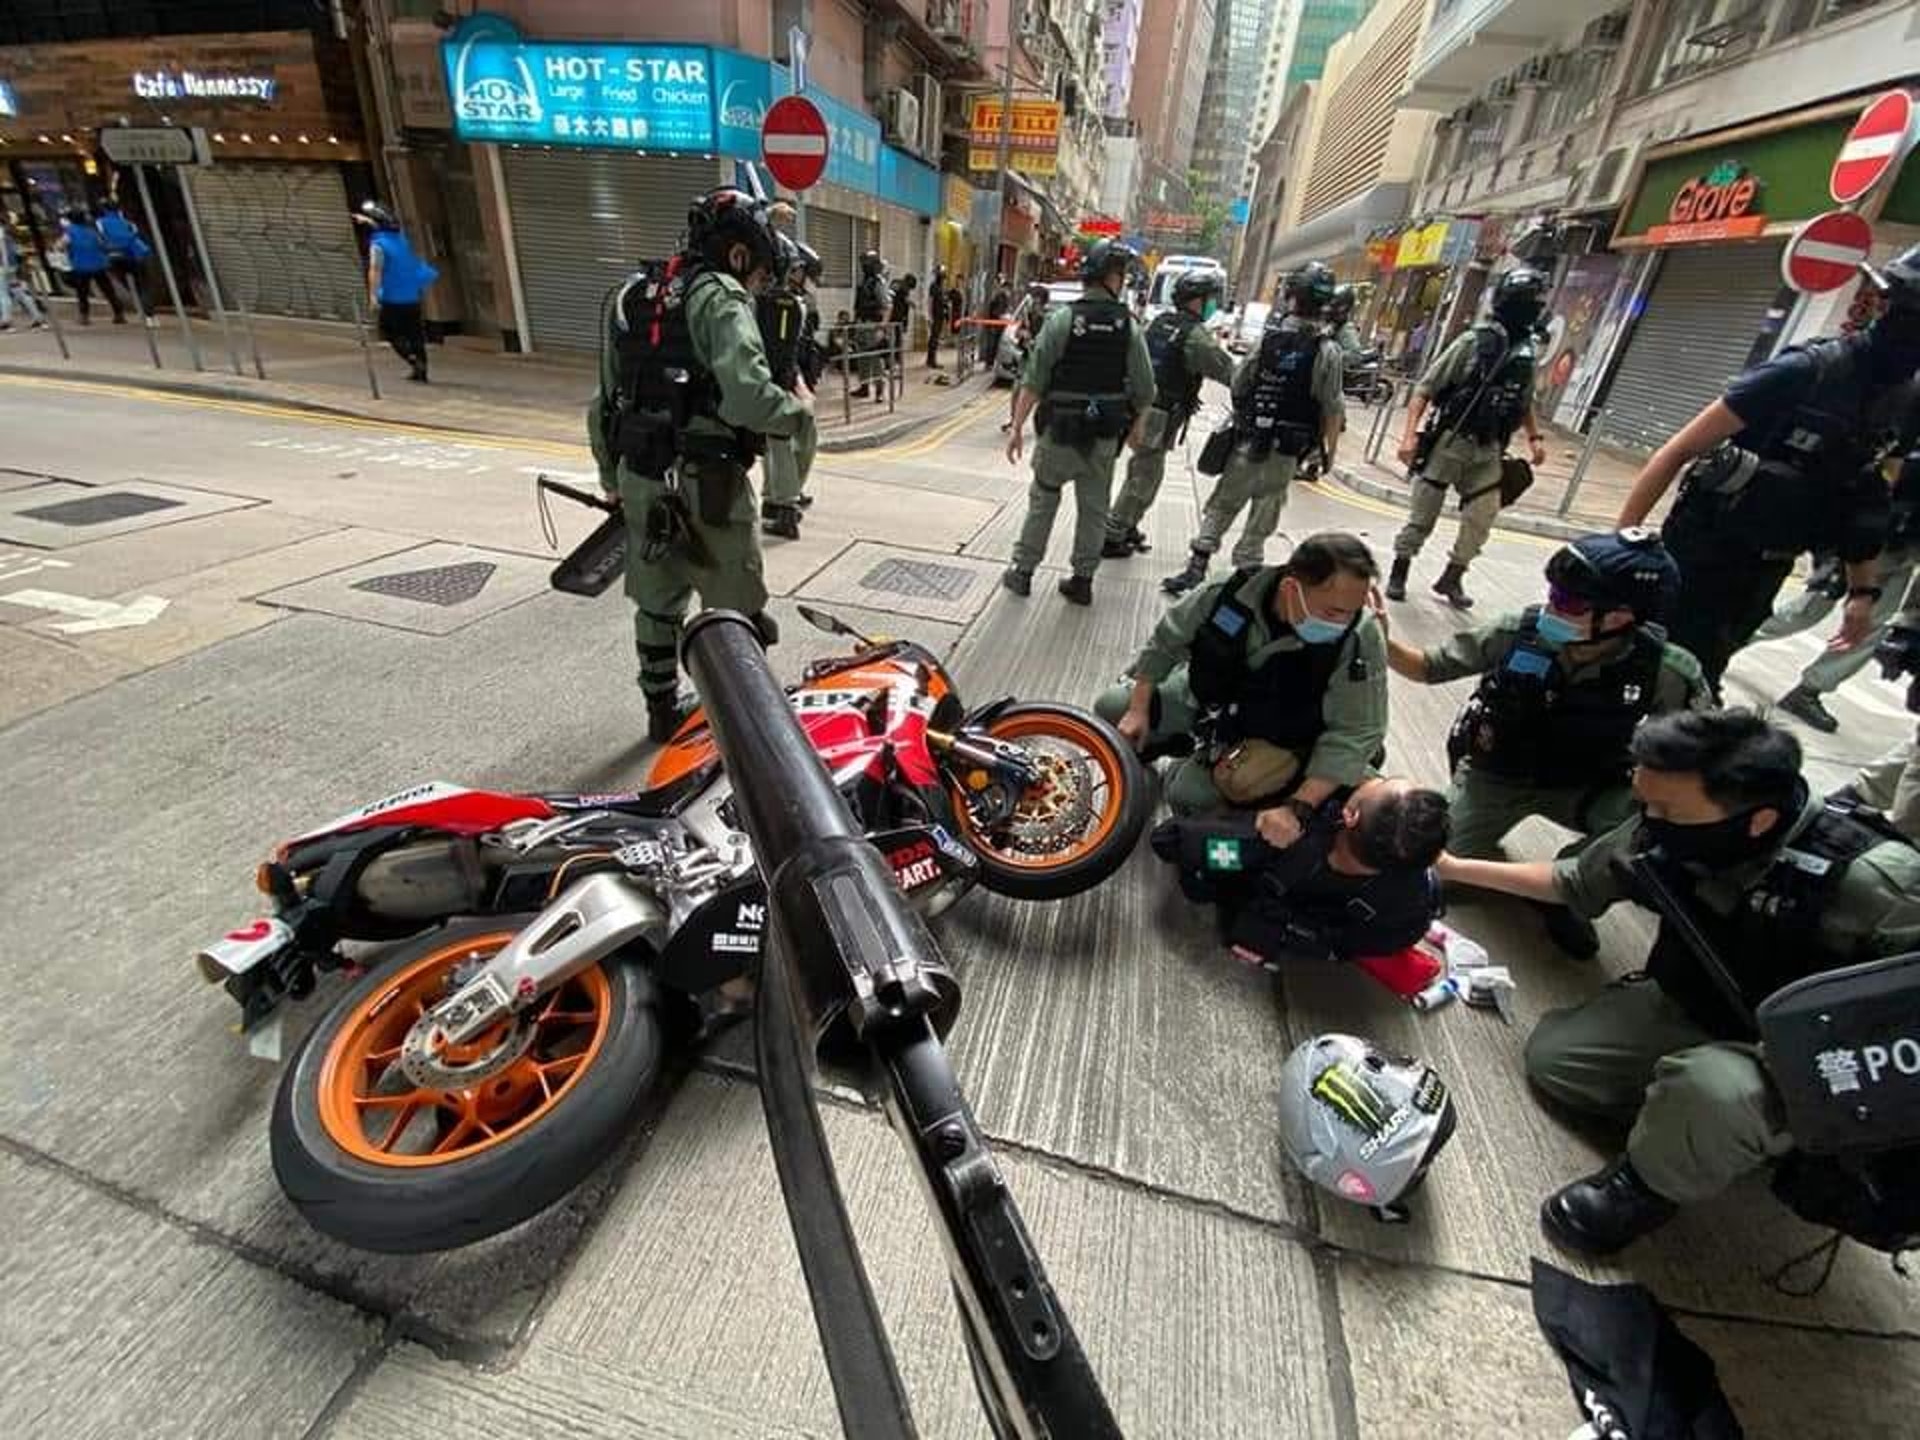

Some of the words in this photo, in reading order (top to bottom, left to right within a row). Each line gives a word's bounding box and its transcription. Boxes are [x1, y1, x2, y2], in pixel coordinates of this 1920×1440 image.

[182, 71, 270, 99] Hennessy
[468, 82, 531, 102] HOT
[652, 87, 708, 105] Chicken
[463, 101, 534, 119] STAR
[1669, 176, 1755, 222] Grove
